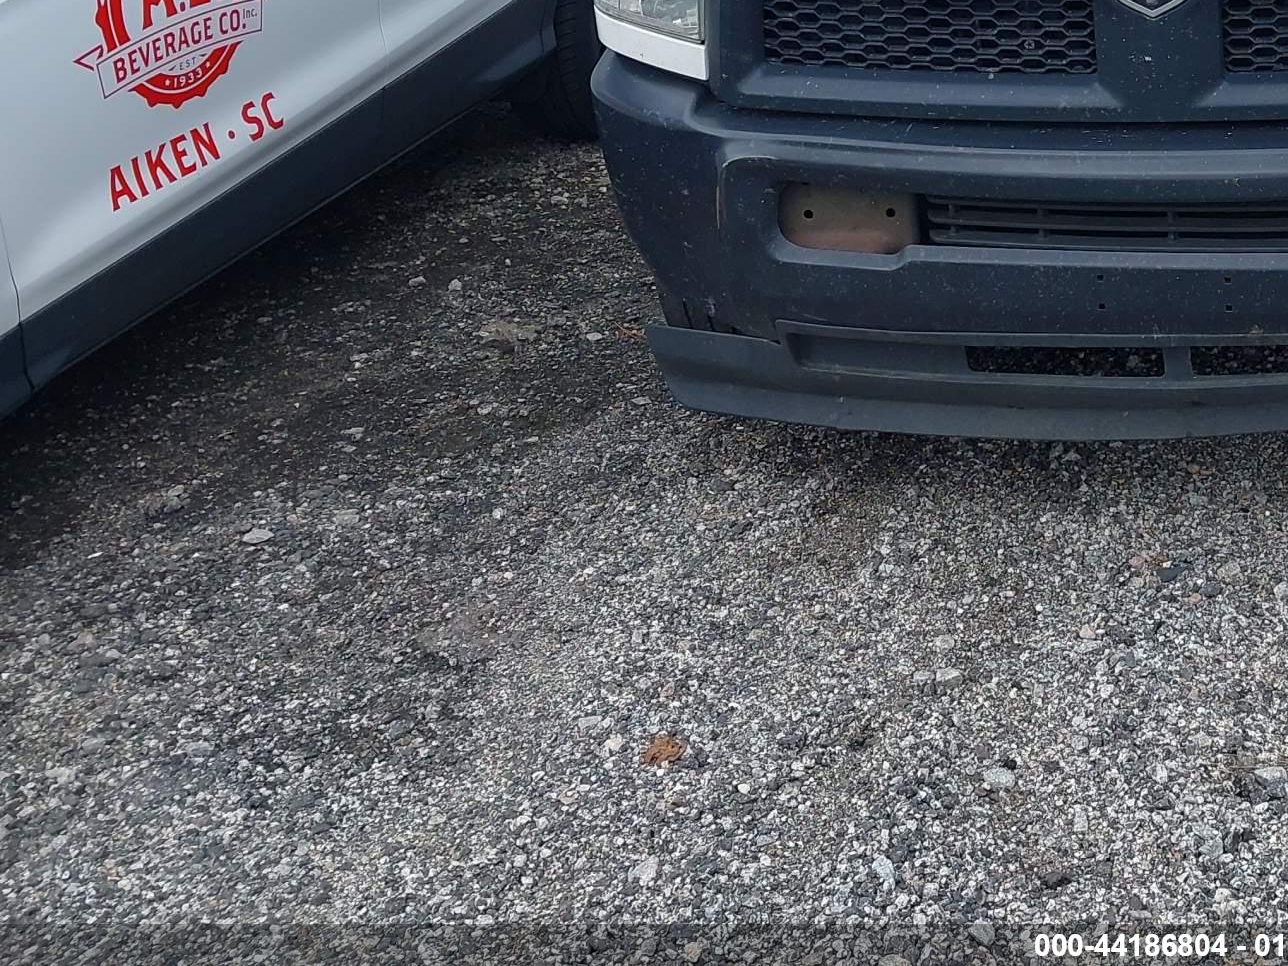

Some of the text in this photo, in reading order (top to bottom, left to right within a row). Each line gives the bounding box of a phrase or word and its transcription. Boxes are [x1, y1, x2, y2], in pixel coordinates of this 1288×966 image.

[113, 8, 258, 84] BEVERAGE CO. Inc.
[179, 56, 197, 71] EST
[173, 67, 203, 88] 1933
[110, 92, 284, 212] AIKEN SC
